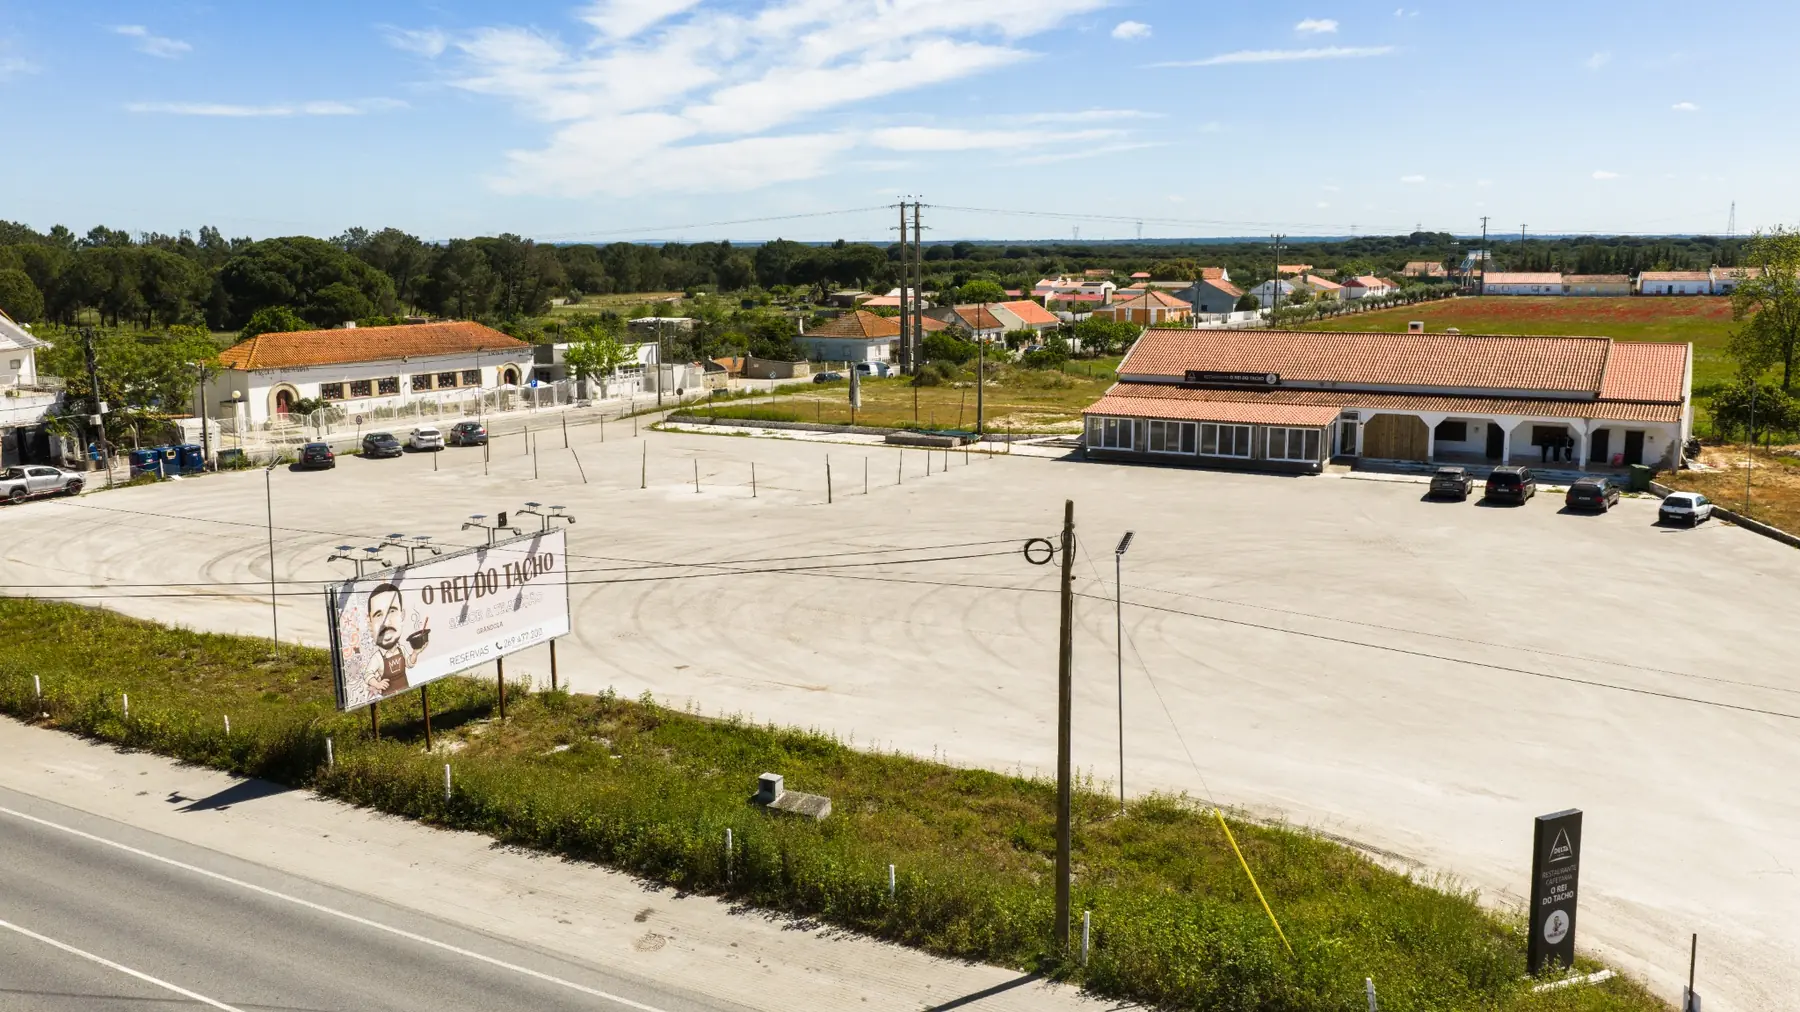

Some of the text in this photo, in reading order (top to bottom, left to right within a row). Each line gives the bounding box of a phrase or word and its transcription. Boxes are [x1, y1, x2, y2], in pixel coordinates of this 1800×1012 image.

[422, 552, 553, 605] O REI DO TACHO
[449, 645, 490, 667] RESERVAS
[1542, 865, 1576, 878] RESTAURANTE
[1550, 884, 1567, 895] O REI
[1543, 892, 1573, 905] DO TACHO
